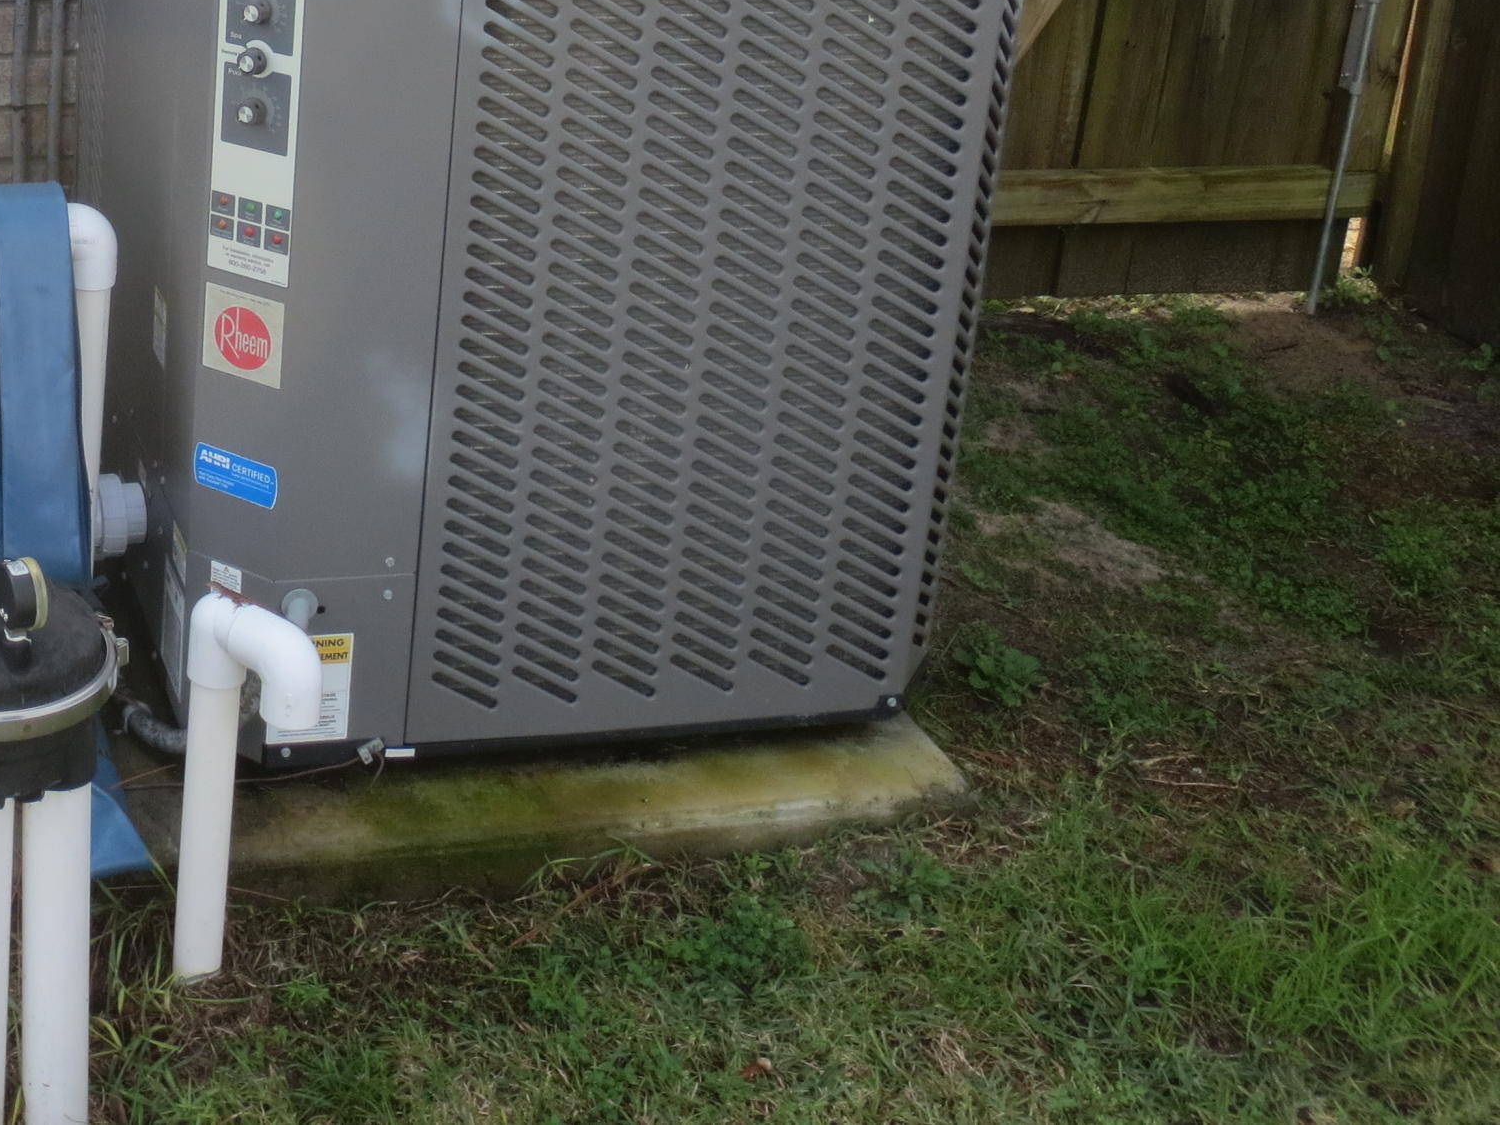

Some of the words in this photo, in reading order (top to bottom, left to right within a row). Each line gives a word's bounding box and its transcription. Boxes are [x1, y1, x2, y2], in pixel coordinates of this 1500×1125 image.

[220, 307, 269, 360] Rheem
[231, 463, 271, 484] CERTIFIED
[313, 638, 345, 648] NING
